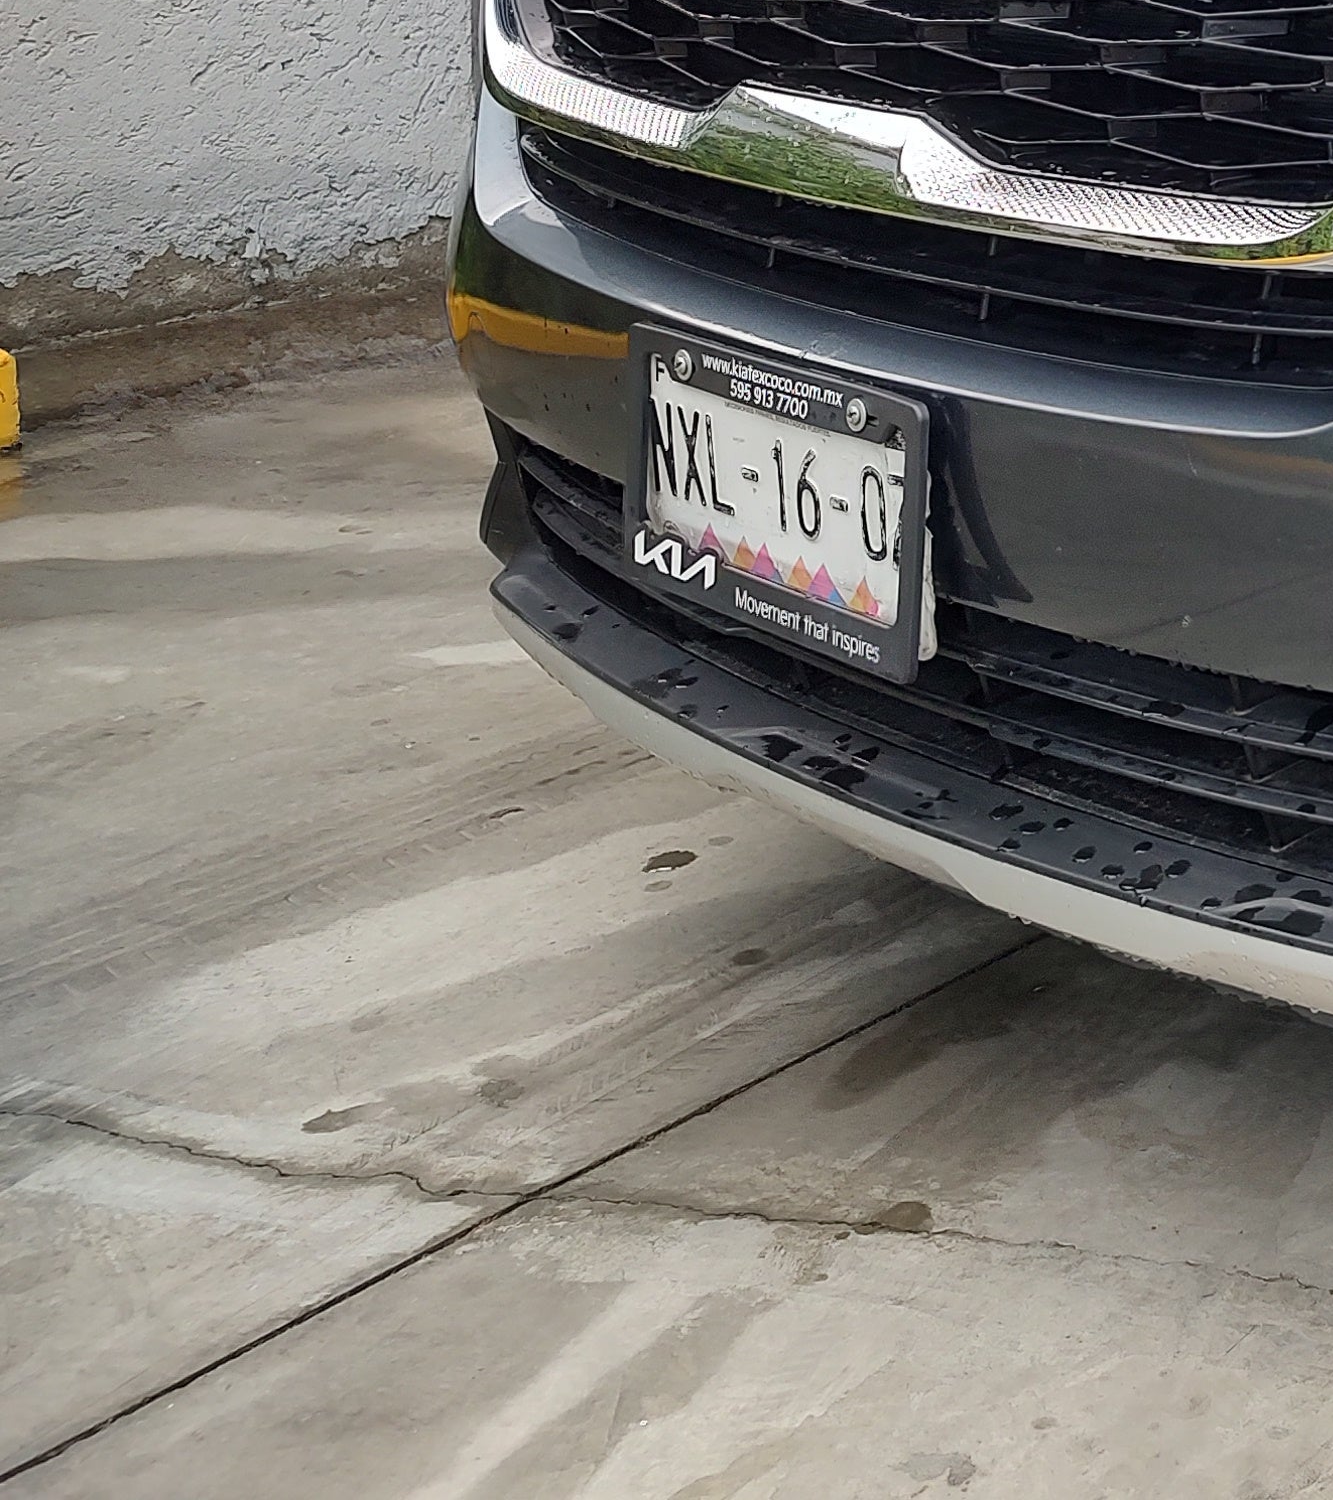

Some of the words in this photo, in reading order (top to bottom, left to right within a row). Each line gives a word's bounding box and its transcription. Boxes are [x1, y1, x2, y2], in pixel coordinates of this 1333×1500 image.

[702, 354, 844, 408] www.kiatexcoco.com.mx
[730, 379, 752, 401] 595
[754, 386, 774, 409] 913
[776, 392, 809, 420] 7700
[633, 530, 717, 590] KIA
[735, 587, 801, 632] Movement
[804, 614, 829, 639] that
[832, 624, 881, 663] inspires
